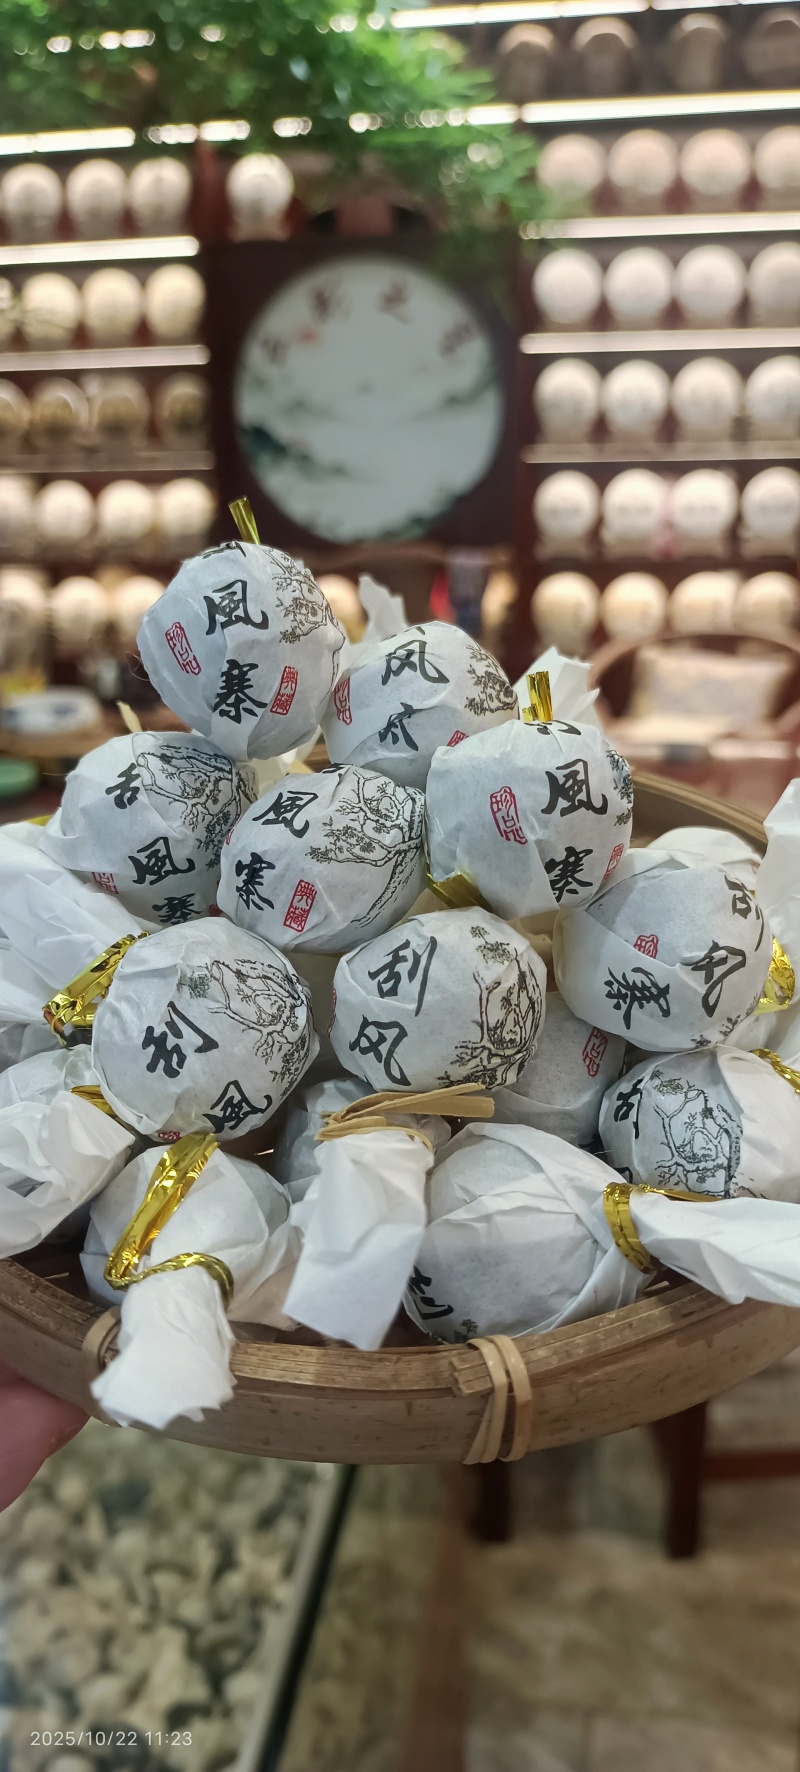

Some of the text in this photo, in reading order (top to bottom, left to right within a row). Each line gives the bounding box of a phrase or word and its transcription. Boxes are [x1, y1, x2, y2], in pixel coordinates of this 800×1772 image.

[202, 540, 270, 725] 風寨
[236, 763, 350, 911] 風寨
[141, 1001, 273, 1134] 刮風
[349, 936, 438, 1087] 刮风
